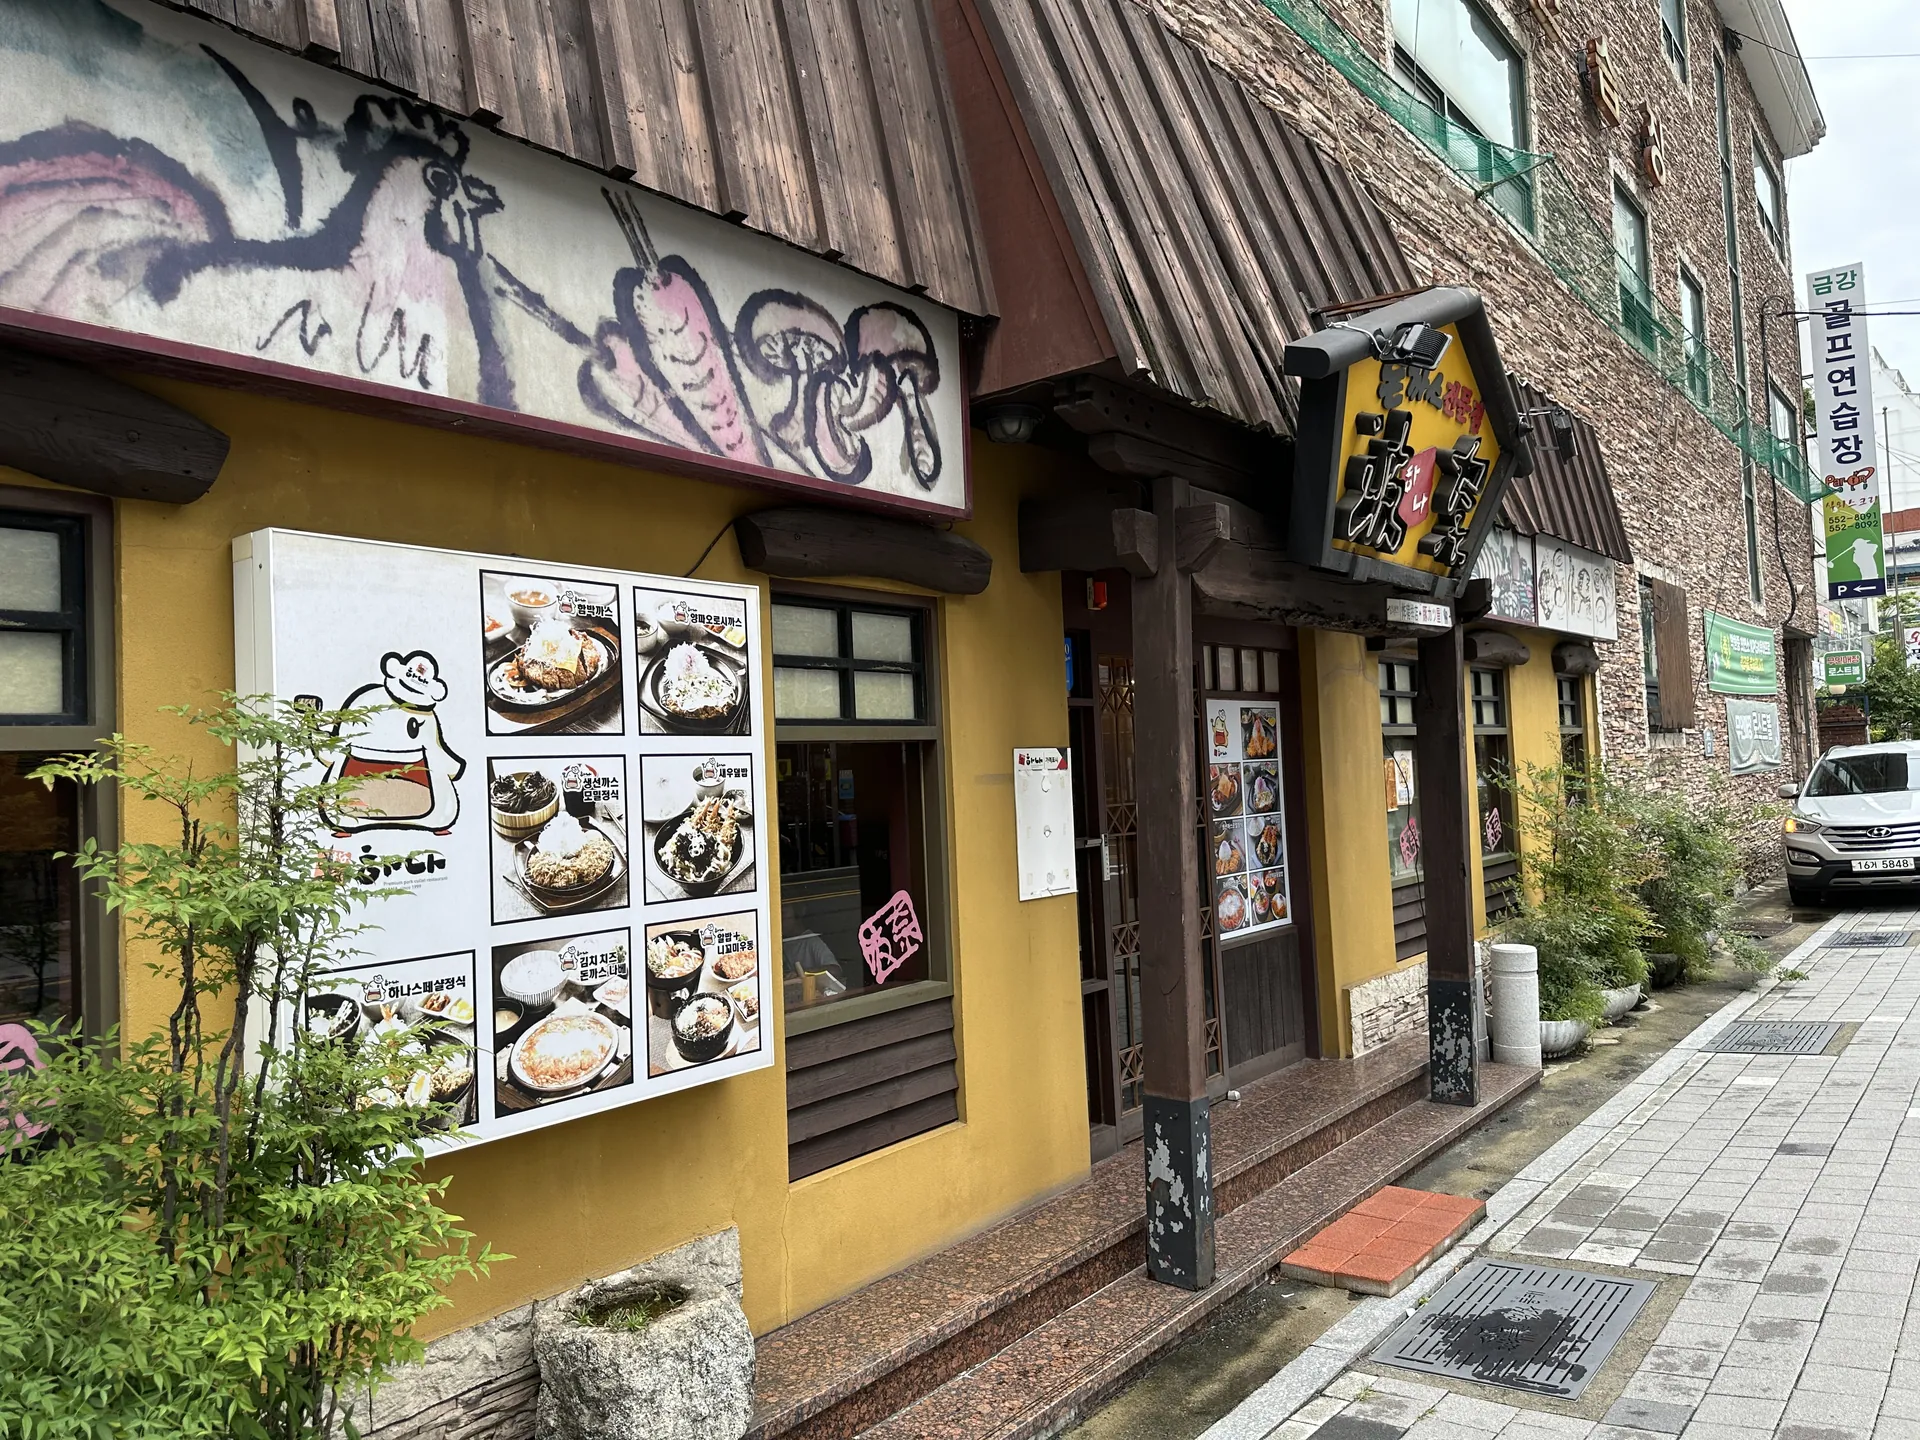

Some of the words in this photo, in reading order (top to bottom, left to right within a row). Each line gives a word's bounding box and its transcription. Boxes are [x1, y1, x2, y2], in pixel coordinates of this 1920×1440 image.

[1812, 269, 1857, 296] 금강
[1823, 298, 1863, 465] 골프연습장
[1443, 380, 1485, 435] 전문점
[1404, 464, 1428, 514] 하나
[1828, 512, 1877, 524] 552-8091
[1829, 520, 1879, 532] 552-8092
[1837, 585, 1848, 596] P
[577, 603, 613, 617] 함박까스
[690, 612, 742, 627] 양파오로시까스
[719, 767, 748, 778] 새우덮밥
[583, 776, 619, 788] 생선까스
[583, 789, 619, 801] 모밀정식
[1882, 859, 1909, 869] 5848
[717, 940, 754, 955] 니꼬미우동
[580, 954, 598, 968] 김치
[599, 951, 617, 964] 치즈
[580, 966, 607, 982] 돈까스
[388, 975, 466, 998] 하나스페샬정식
